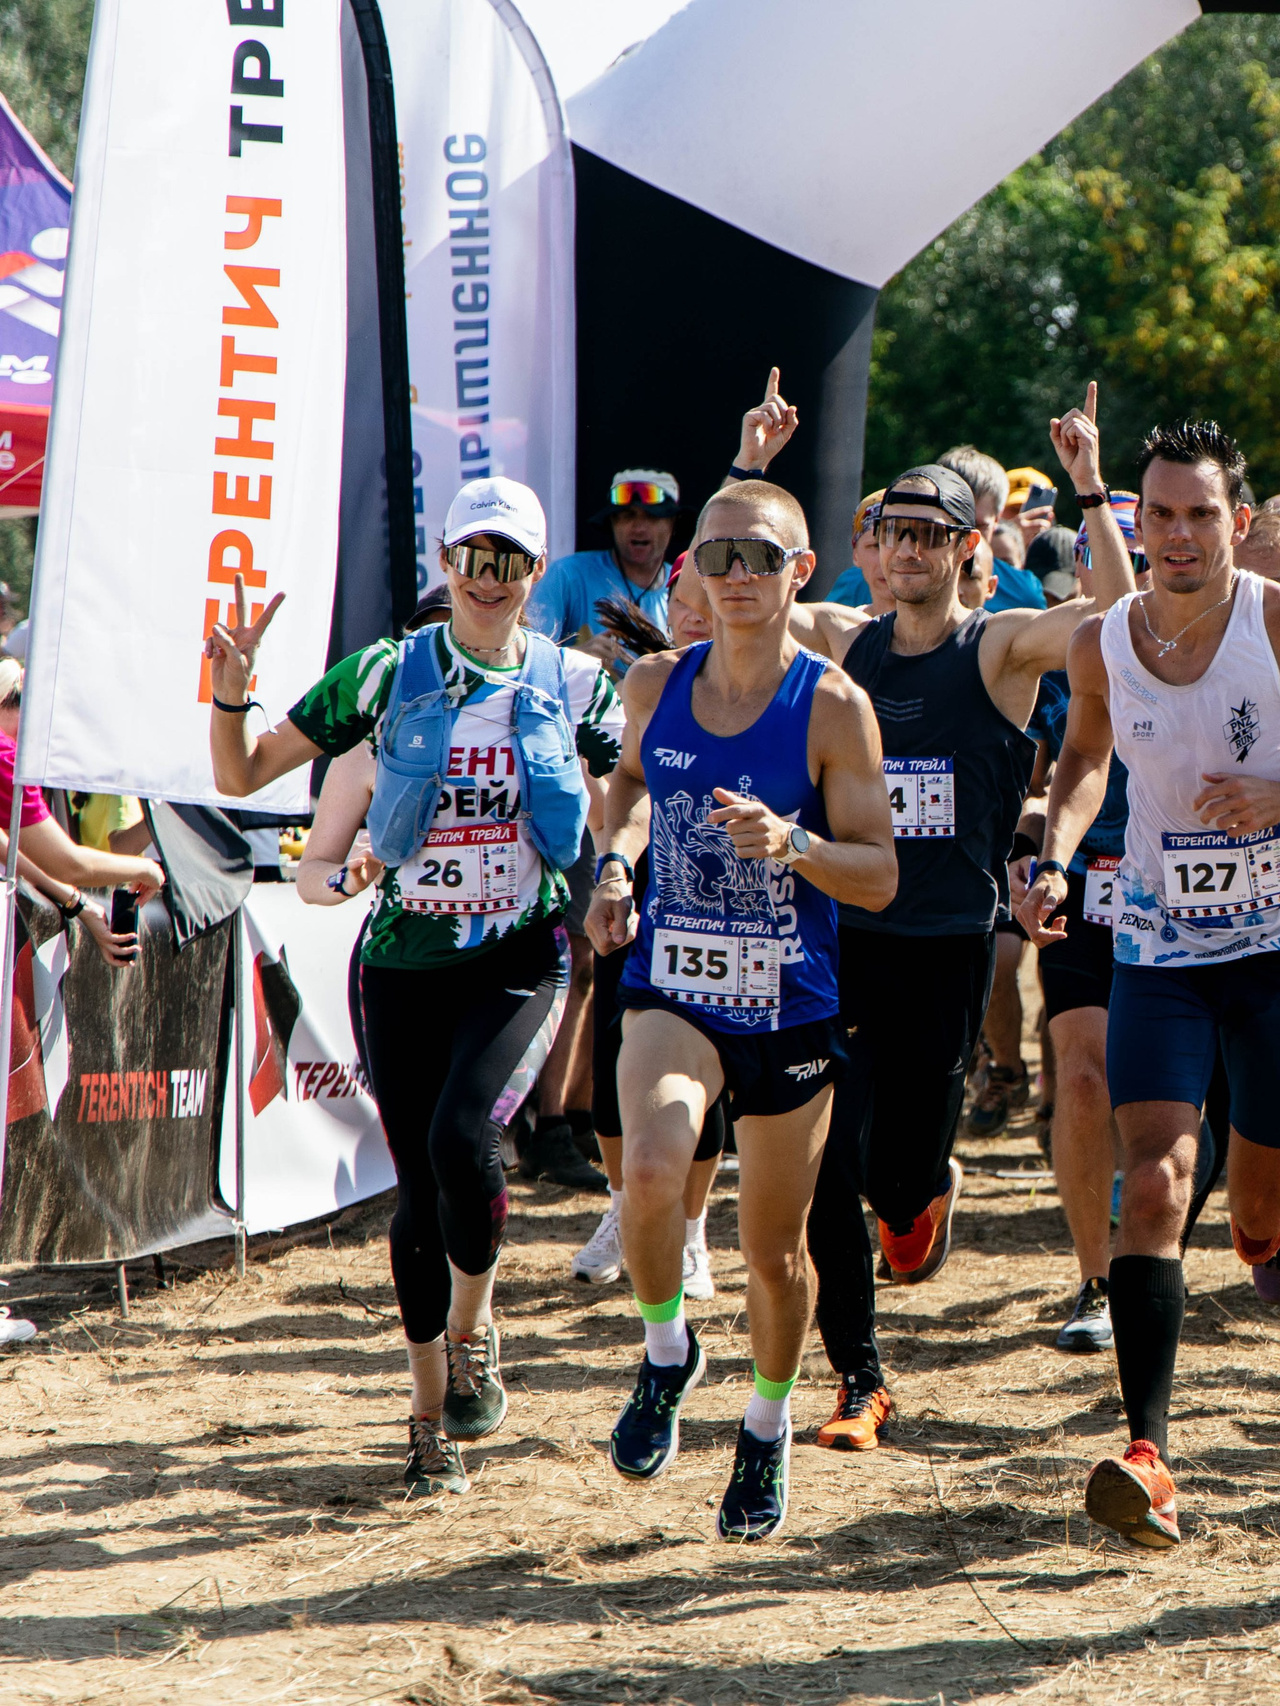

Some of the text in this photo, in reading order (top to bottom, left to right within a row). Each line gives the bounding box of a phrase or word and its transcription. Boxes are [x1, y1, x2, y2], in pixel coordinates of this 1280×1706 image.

[470, 500, 519, 513] Calvin Klein
[1230, 714, 1253, 734] PNZ
[1235, 732, 1253, 750] RUN
[653, 748, 697, 770] RAY
[908, 758, 946, 771] ТРЕЙЛ
[469, 827, 511, 841] ТРЕЙЛ
[1168, 835, 1228, 847] ТЕРЕНТИЧ
[417, 859, 463, 888] 26
[1174, 863, 1237, 894] 127
[664, 914, 772, 935] ТЕРЕНТИЧ ТРЕЙЛ
[1119, 912, 1156, 932] PENZA
[1166, 930, 1173, 938] 3
[664, 944, 728, 980] 135
[784, 1059, 830, 1081] RAY
[77, 1068, 207, 1123] TERENTICH TEAM
